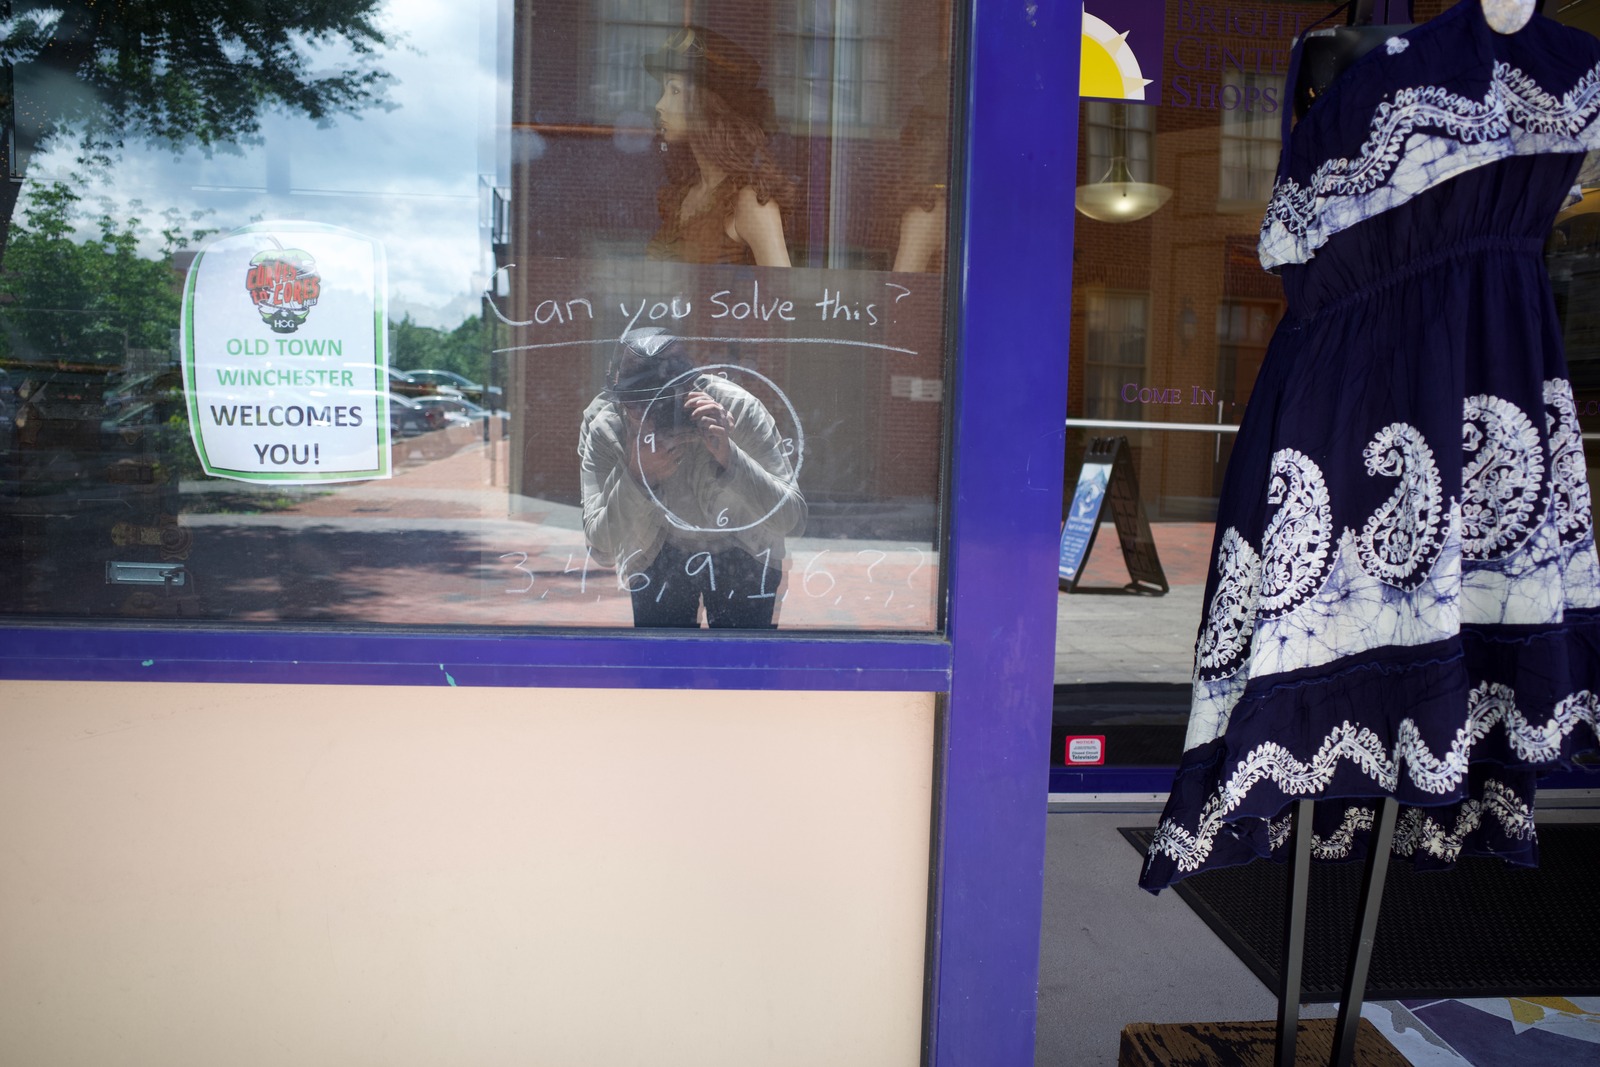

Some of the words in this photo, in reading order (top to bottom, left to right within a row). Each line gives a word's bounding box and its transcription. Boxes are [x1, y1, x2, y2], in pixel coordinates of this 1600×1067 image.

[1177, 0, 1308, 39] BRIGHT
[1173, 36, 1288, 76] CENTE
[1171, 75, 1278, 112] SHOPS
[247, 261, 297, 289] CURVES
[273, 277, 319, 305] CORES
[484, 263, 592, 327] Can
[620, 296, 692, 342] you
[816, 283, 911, 326] this?
[274, 319, 295, 328] HOG
[226, 338, 269, 356] OLD
[275, 338, 342, 356] TOWN
[216, 368, 354, 387] WINCHESTER
[210, 404, 363, 428] WELCOMES
[253, 442, 320, 465] YOU!
[643, 432, 656, 453] 9
[781, 438, 795, 457] 3
[716, 507, 729, 527] 6
